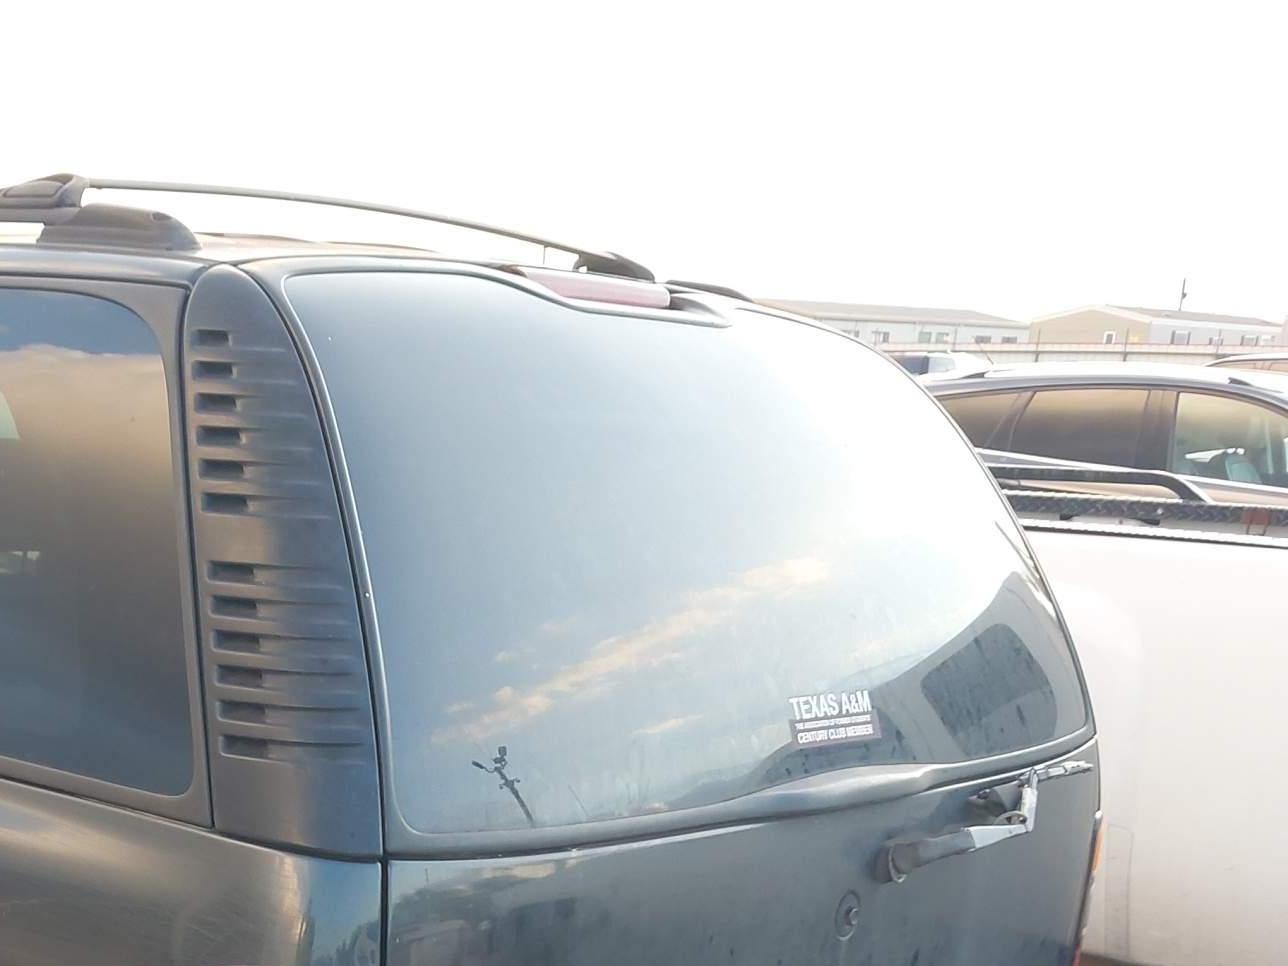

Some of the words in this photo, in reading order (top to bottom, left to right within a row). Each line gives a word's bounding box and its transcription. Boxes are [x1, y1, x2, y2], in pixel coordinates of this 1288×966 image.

[789, 693, 839, 719] TEXAS
[841, 690, 871, 714] A&M
[828, 727, 846, 740] CLUB
